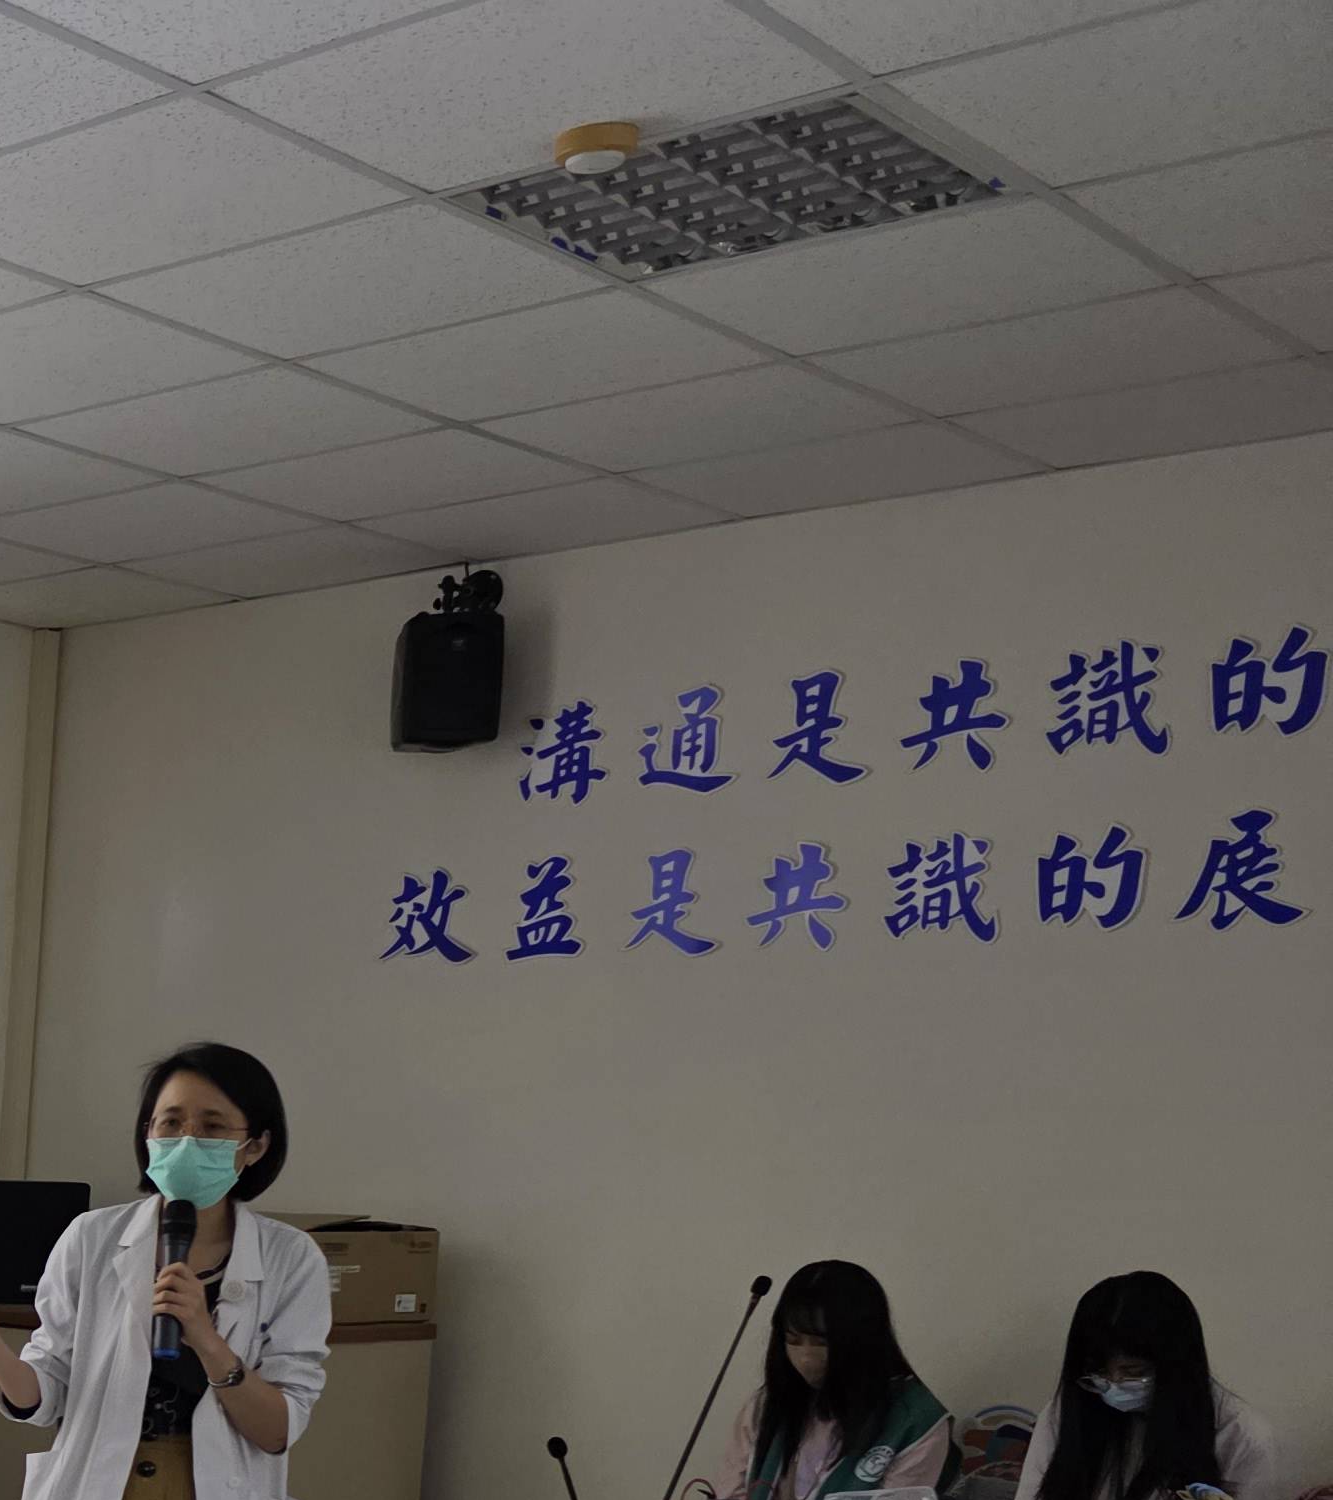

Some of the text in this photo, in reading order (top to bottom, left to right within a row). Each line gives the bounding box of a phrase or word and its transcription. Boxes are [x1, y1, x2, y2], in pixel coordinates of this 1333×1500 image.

[519, 626, 1328, 803] 溝通是共識的
[378, 809, 1309, 963] 效益是共識的展
